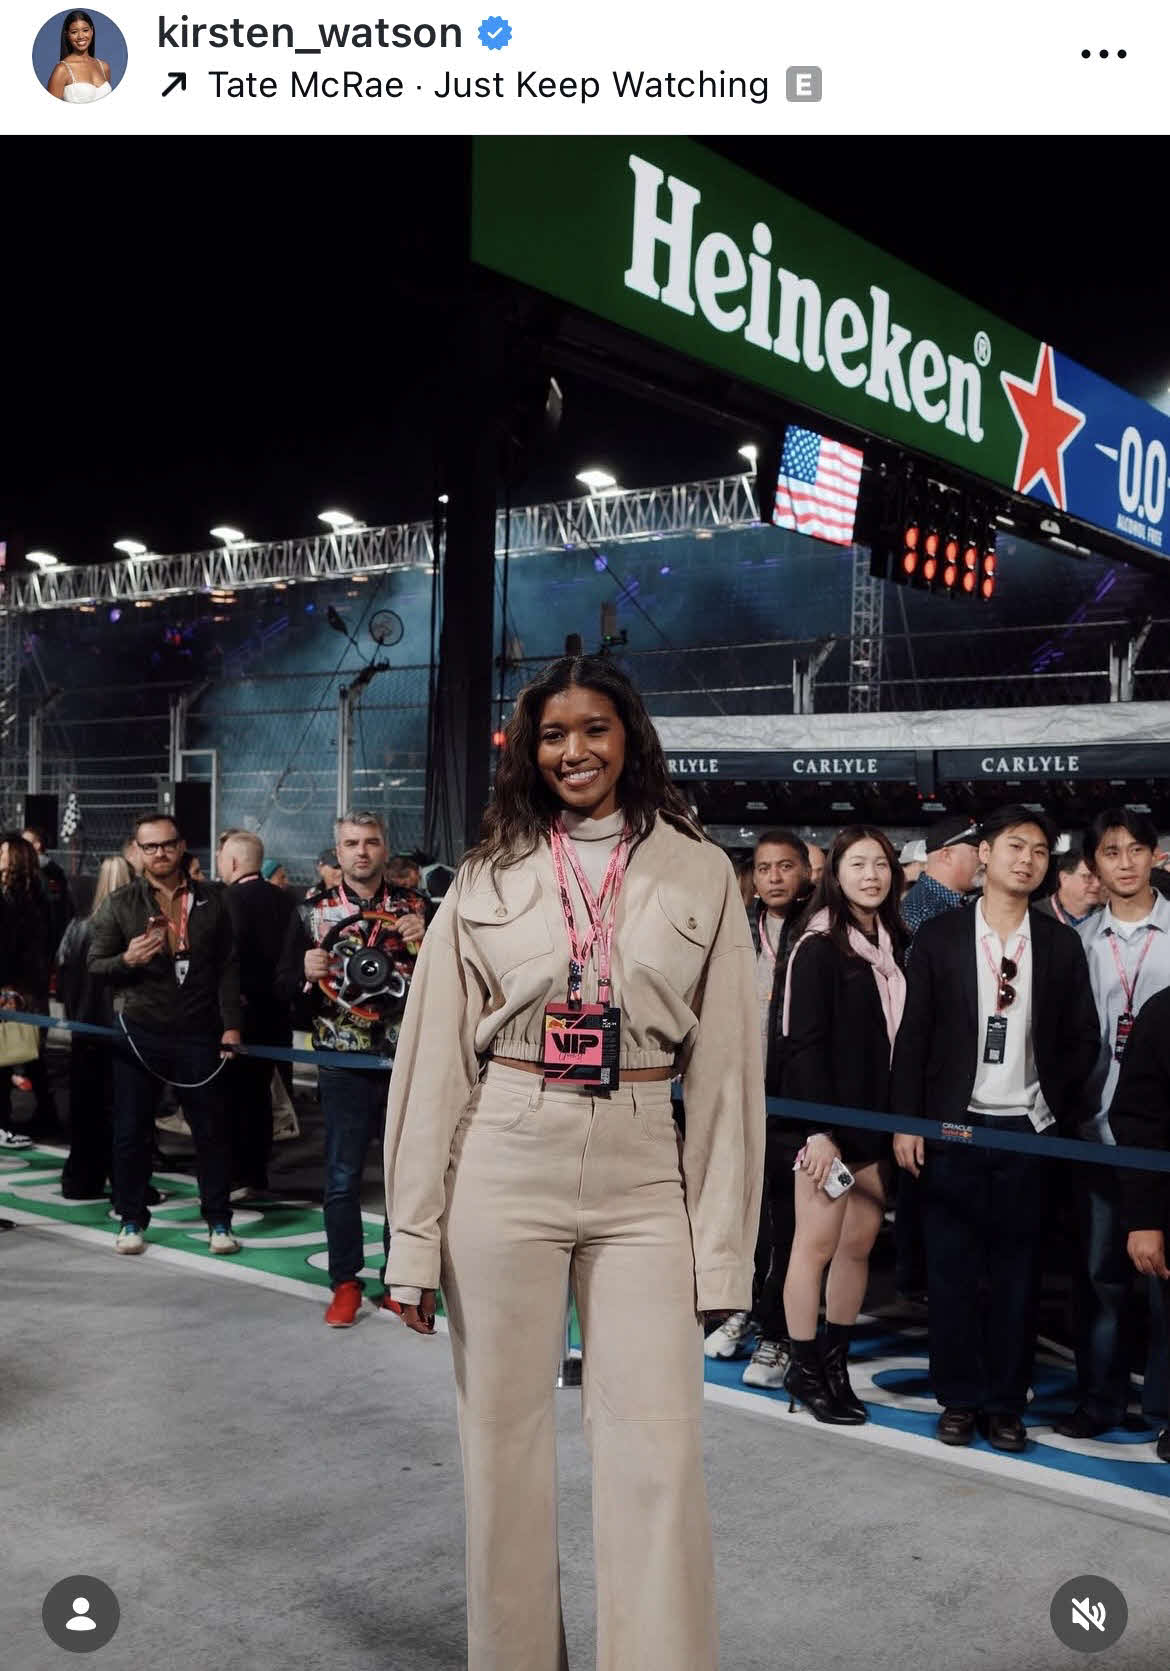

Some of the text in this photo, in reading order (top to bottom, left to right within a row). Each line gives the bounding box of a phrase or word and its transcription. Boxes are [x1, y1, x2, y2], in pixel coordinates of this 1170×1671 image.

[668, 758, 719, 773] RLYLE
[792, 758, 878, 774] CARLYLE
[981, 756, 1080, 773] CARLYLE
[551, 1032, 600, 1055] VIP
